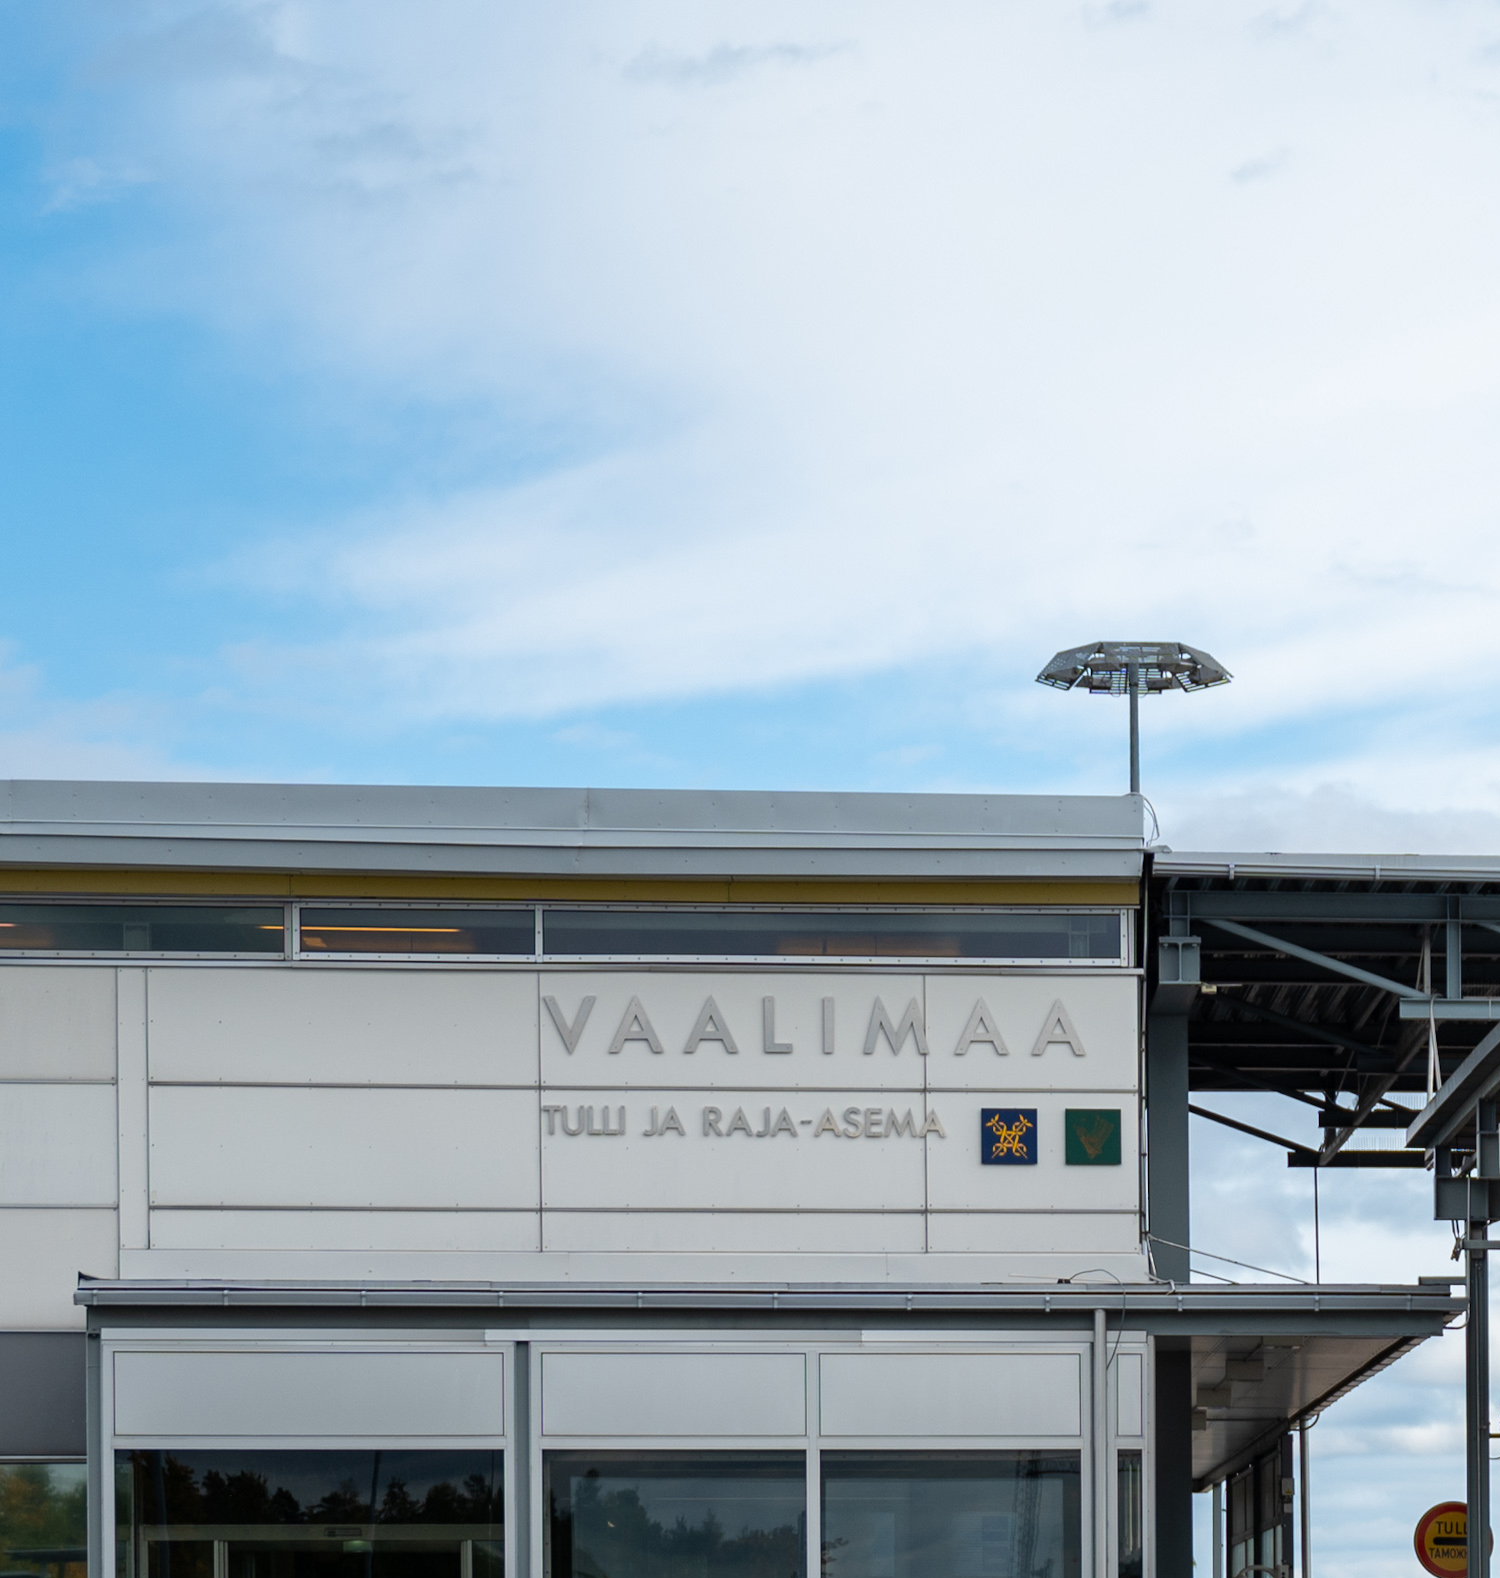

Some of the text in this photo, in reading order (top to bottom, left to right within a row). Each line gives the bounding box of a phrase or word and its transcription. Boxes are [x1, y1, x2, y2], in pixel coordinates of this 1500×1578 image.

[542, 994, 1087, 1057] VAALIMAA
[541, 1105, 947, 1139] TULLI JA RAJA-ASEMA
[1436, 1521, 1468, 1535] TULL
[1429, 1547, 1468, 1559] ТАМОЖ
